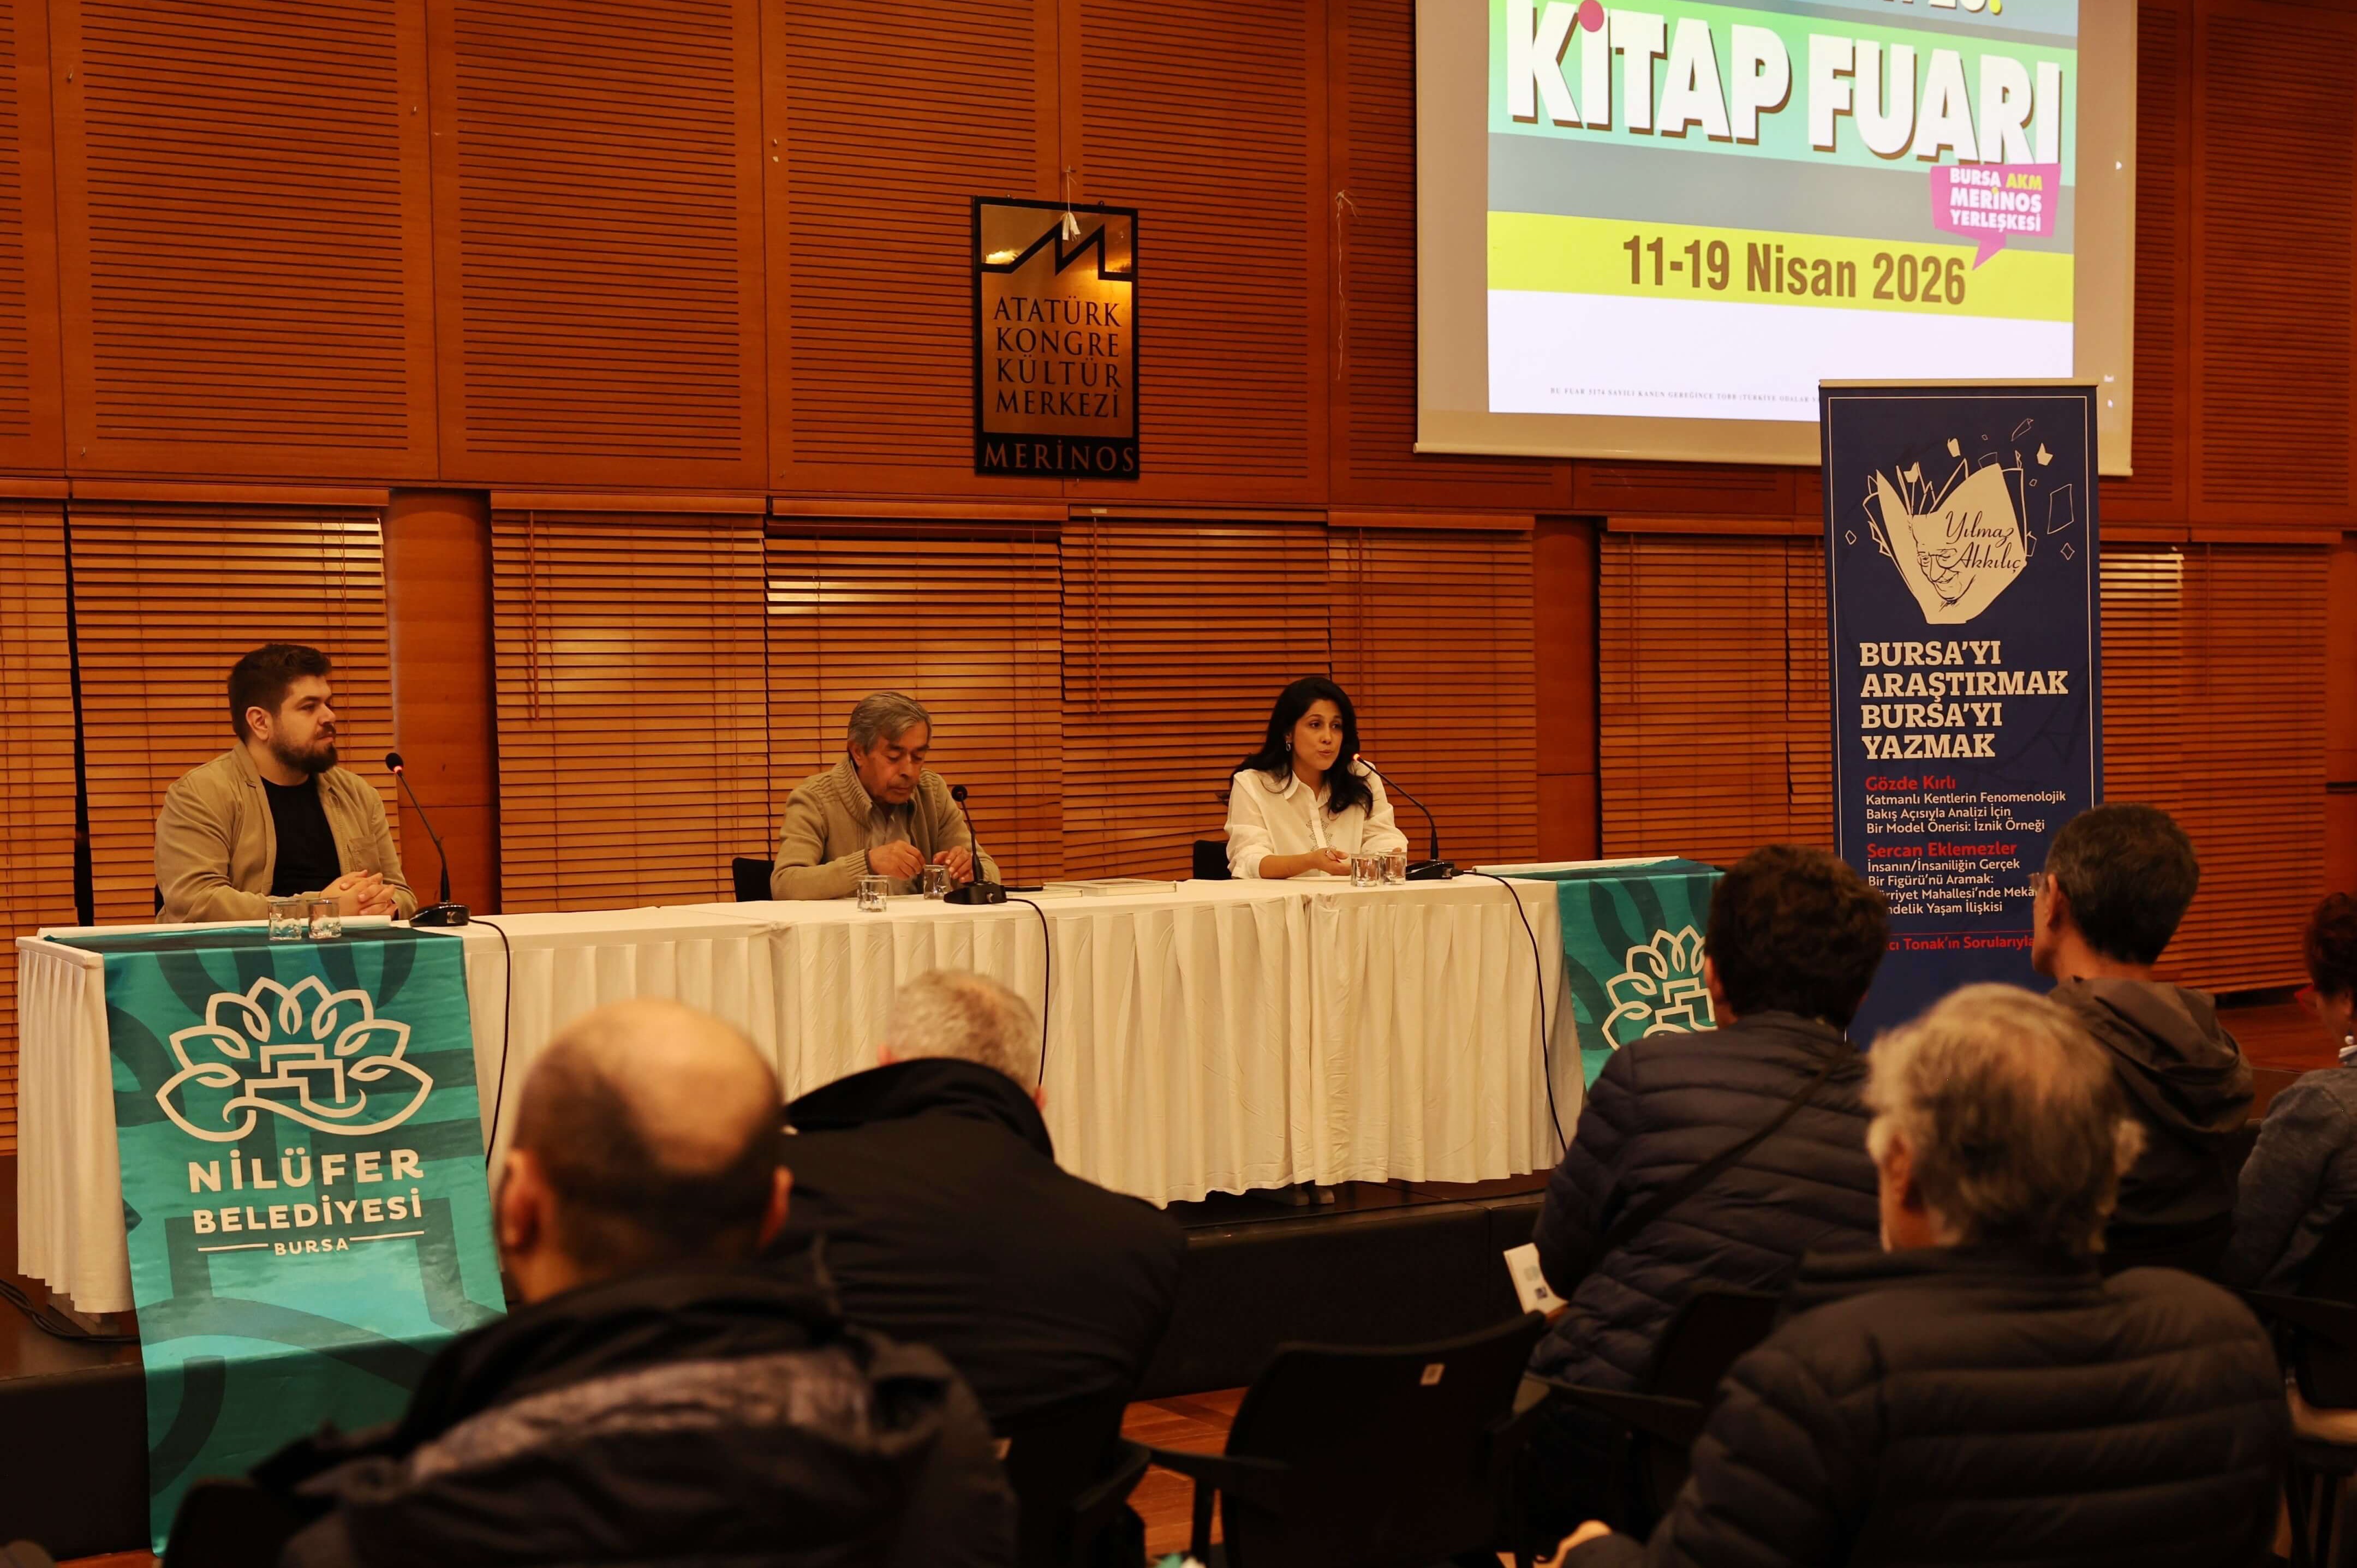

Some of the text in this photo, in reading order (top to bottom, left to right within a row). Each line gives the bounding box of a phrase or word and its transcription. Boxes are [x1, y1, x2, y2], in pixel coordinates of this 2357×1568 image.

[1506, 0, 2061, 165] KİTAP FUARI
[1950, 167, 2043, 191] BURSA AKM
[1950, 187, 2042, 214] MERİNOS
[1950, 209, 2041, 233] YERLEŞKESİ
[1623, 235, 1966, 304] 11-19 Nisan 2026
[994, 296, 1121, 327] ATATÜRK
[996, 327, 1119, 357] KONGRE
[997, 355, 1121, 388] KÜLTÜR
[995, 388, 1119, 418] MERKEZİ
[984, 440, 1134, 472] MERİNOS
[1945, 511, 2014, 548] Yılmaz
[1959, 542, 2021, 573] Akkılıç
[1860, 641, 2001, 667] BURSA'YI
[1860, 671, 2069, 702] ARAŞTIRMAK
[1861, 702, 2002, 729] BURSA'YI
[1861, 733, 1995, 759] YAZMAK
[1865, 775, 1956, 791] Gözde Kırlı
[1866, 791, 2066, 805] Katmanlı Kentlerin Fenomenolojik
[1866, 803, 2011, 821] Bakış Açısıyla Analizi İçin
[1866, 817, 2045, 834] Bir Model Önerisi: İznik Örneği
[1867, 841, 2018, 858] Sercan Eklemezler
[1979, 858, 2020, 872] Gerçek
[1869, 873, 1994, 888] Bir Figürü'nü Aramak:
[1879, 889, 1919, 902] rriyet
[1922, 887, 2001, 900] Mahallesi'nde
[1888, 900, 2003, 916] ndelik Yaşam İlişkisi
[1903, 937, 1960, 950] Tonak'ın
[1964, 935, 2035, 951] Sorularıyla
[187, 1147, 424, 1193] NİLÜFER
[193, 1188, 422, 1234] BELEDİYESİ
[275, 1237, 349, 1256] BURSA
